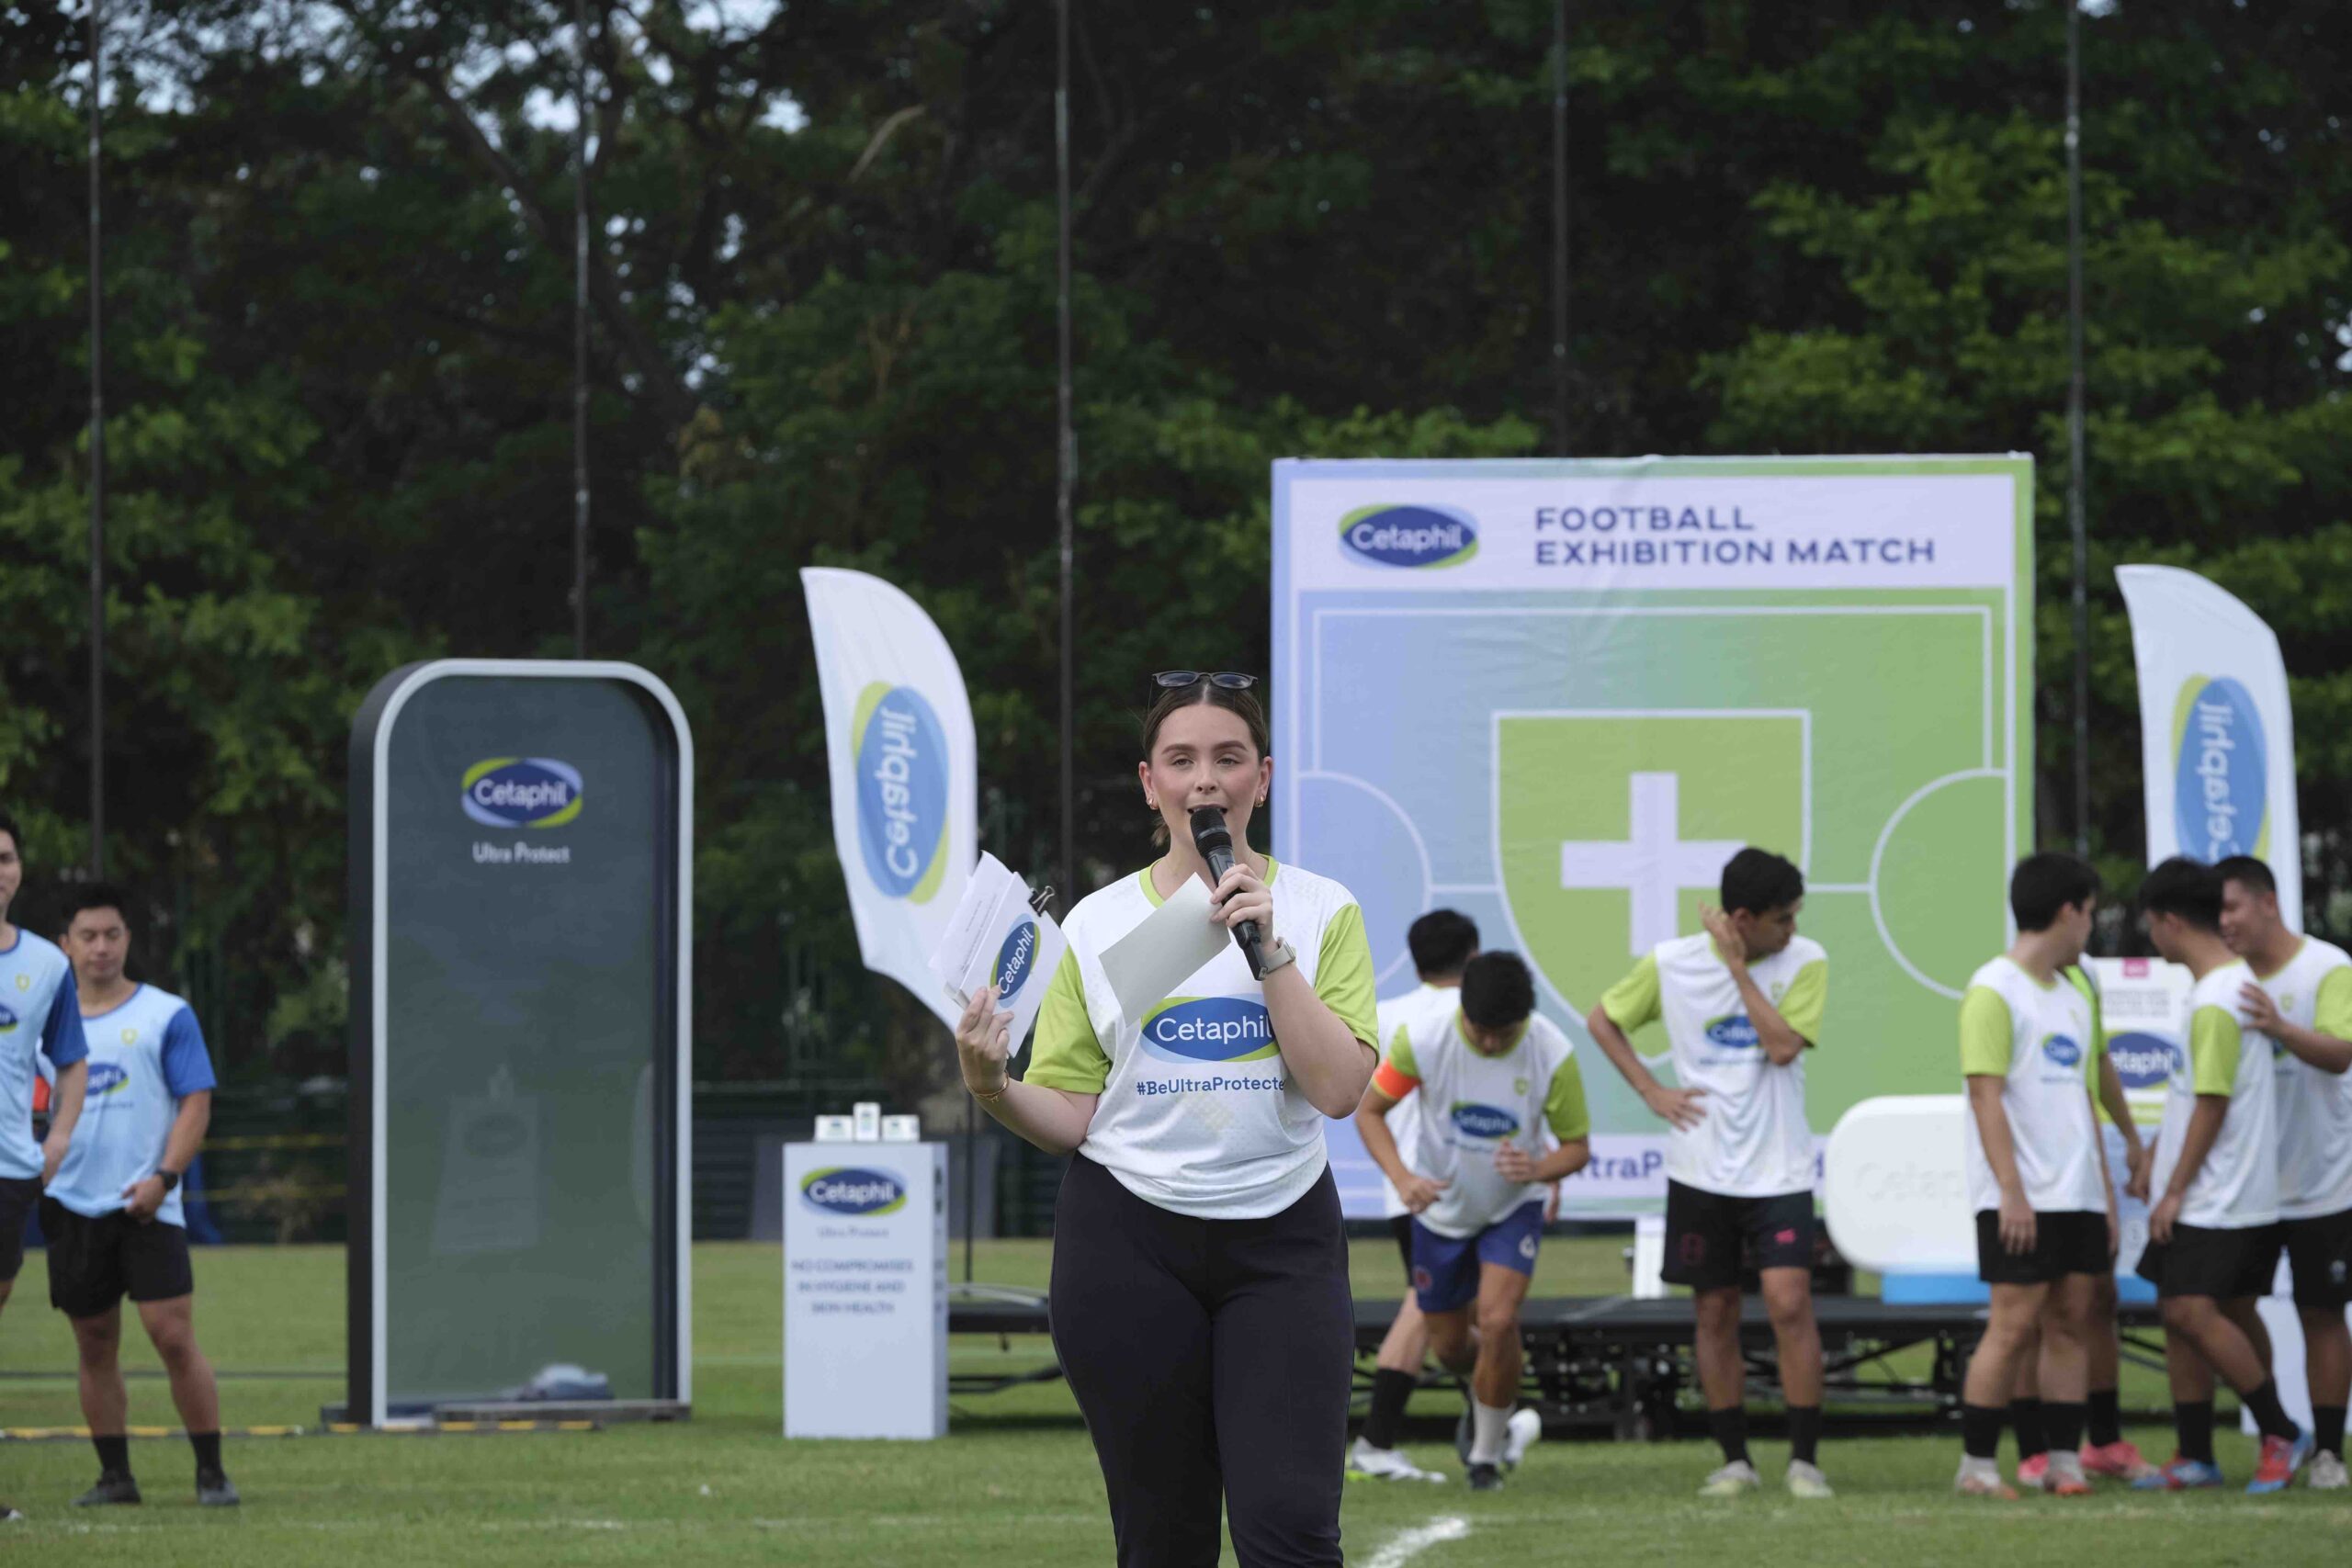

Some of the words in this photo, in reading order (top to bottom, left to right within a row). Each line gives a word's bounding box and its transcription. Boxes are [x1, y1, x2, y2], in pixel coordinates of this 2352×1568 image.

[1535, 507, 1756, 532] FOOTBALL
[1351, 523, 1464, 555] Cetaphil
[1535, 539, 1774, 565] EXHIBITION
[1786, 538, 1936, 564] MATCH
[474, 778, 568, 810] Cetaphil
[472, 840, 513, 863] Ultra
[514, 840, 571, 863] Protect
[998, 927, 1035, 994] Cetaphil
[1156, 1014, 1273, 1045] Cetaphil
[1136, 1076, 1286, 1096] #BeUltraProtecte
[808, 1179, 896, 1205] Cetaphil
